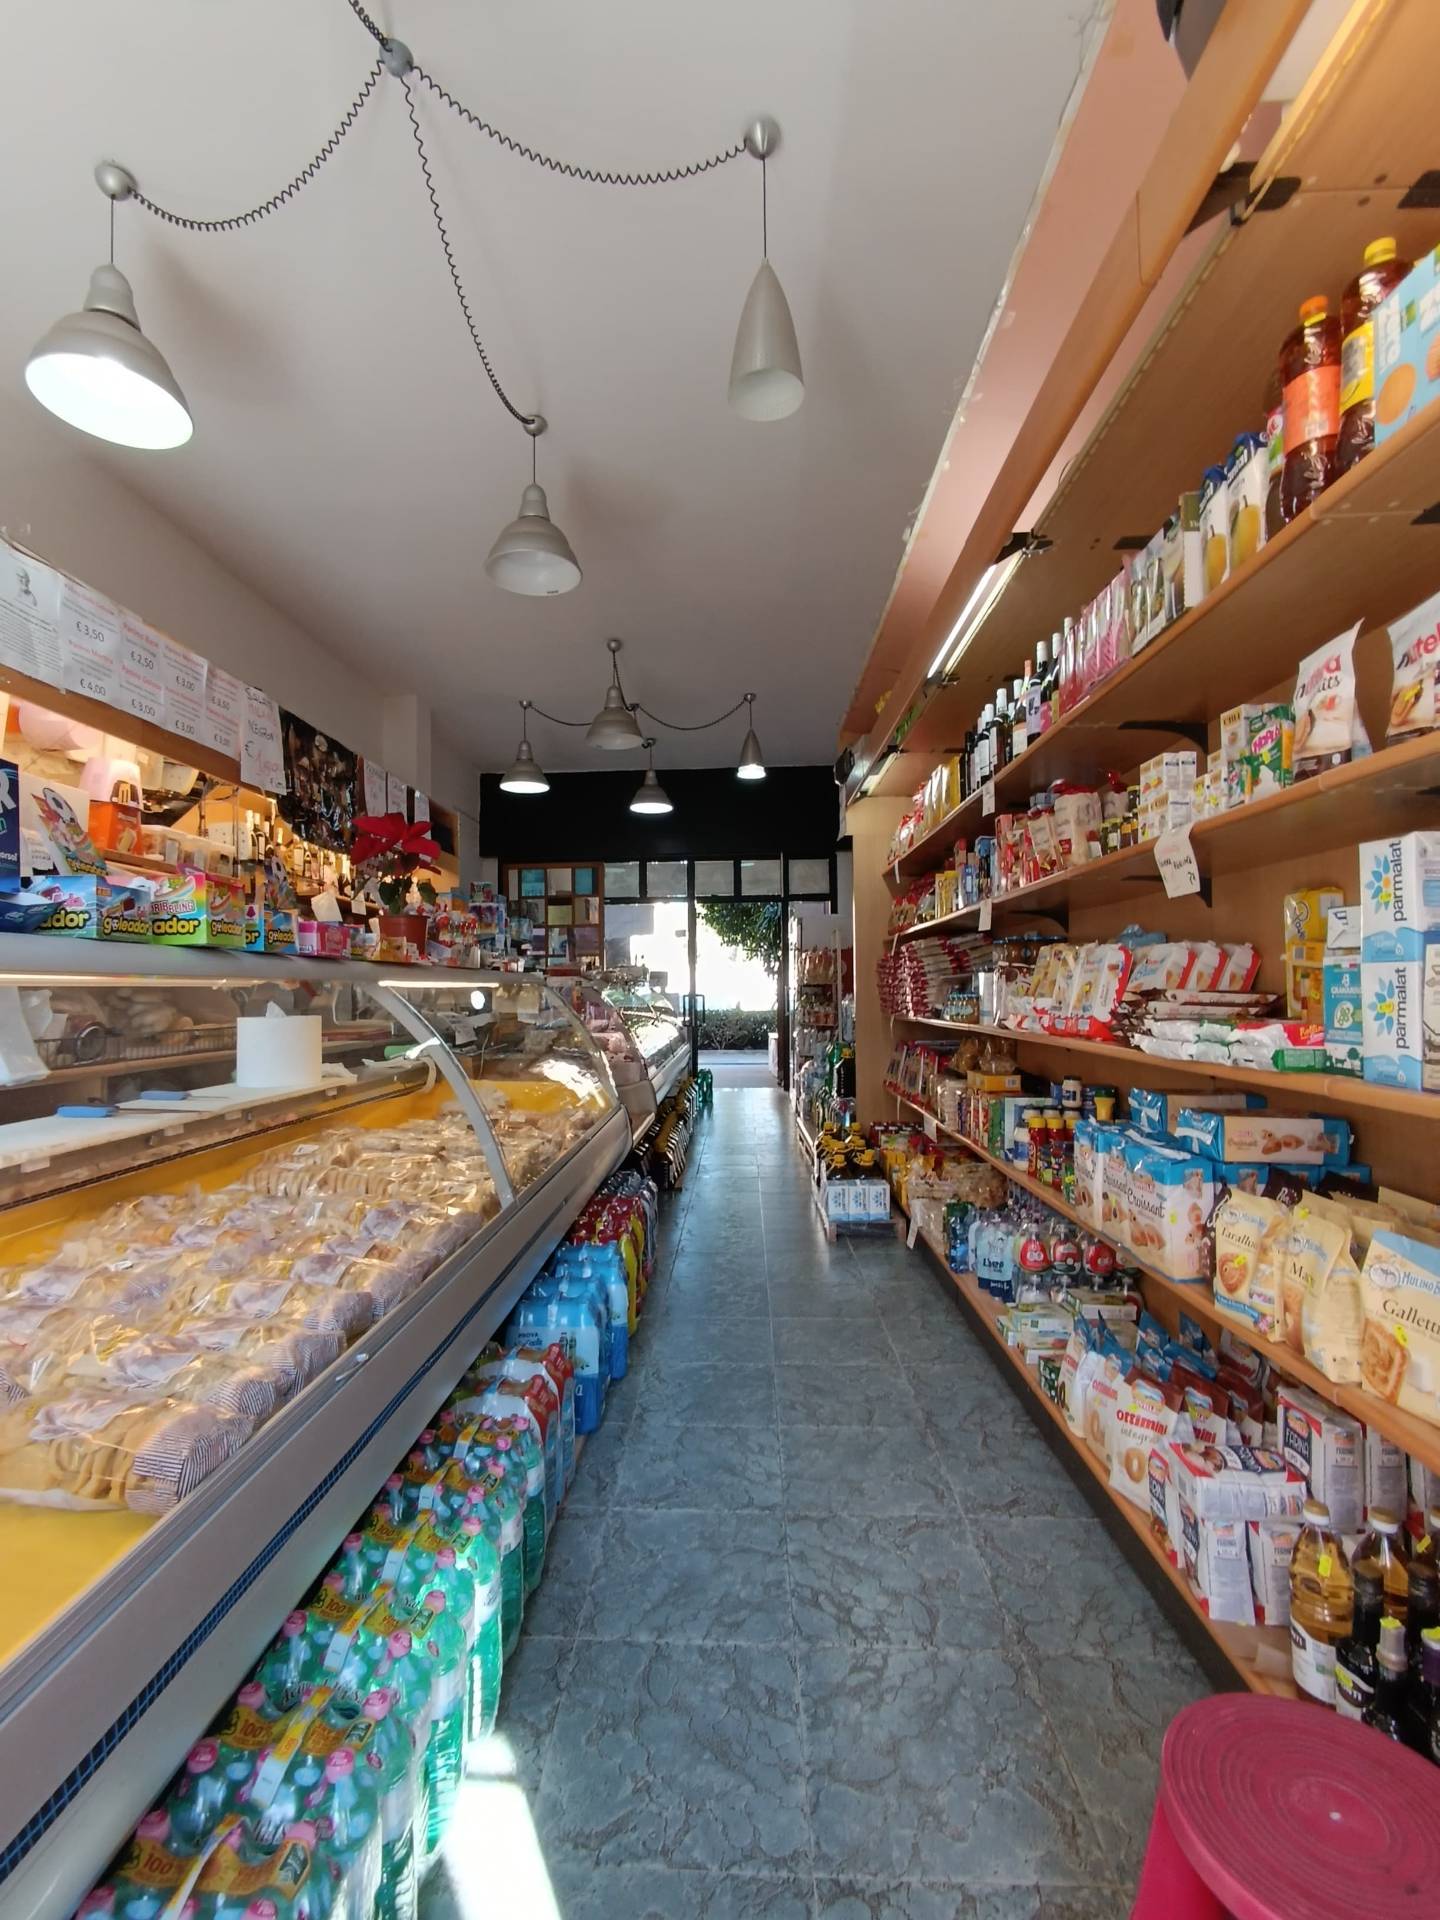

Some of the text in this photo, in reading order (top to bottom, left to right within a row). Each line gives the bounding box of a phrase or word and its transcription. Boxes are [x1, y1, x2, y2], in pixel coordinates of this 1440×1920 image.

[1389, 839, 1407, 922] parmalat
[1395, 967, 1410, 1050] parmalat
[1127, 1187, 1166, 1218] Croissant
[1285, 1428, 1309, 1458] FARINA
